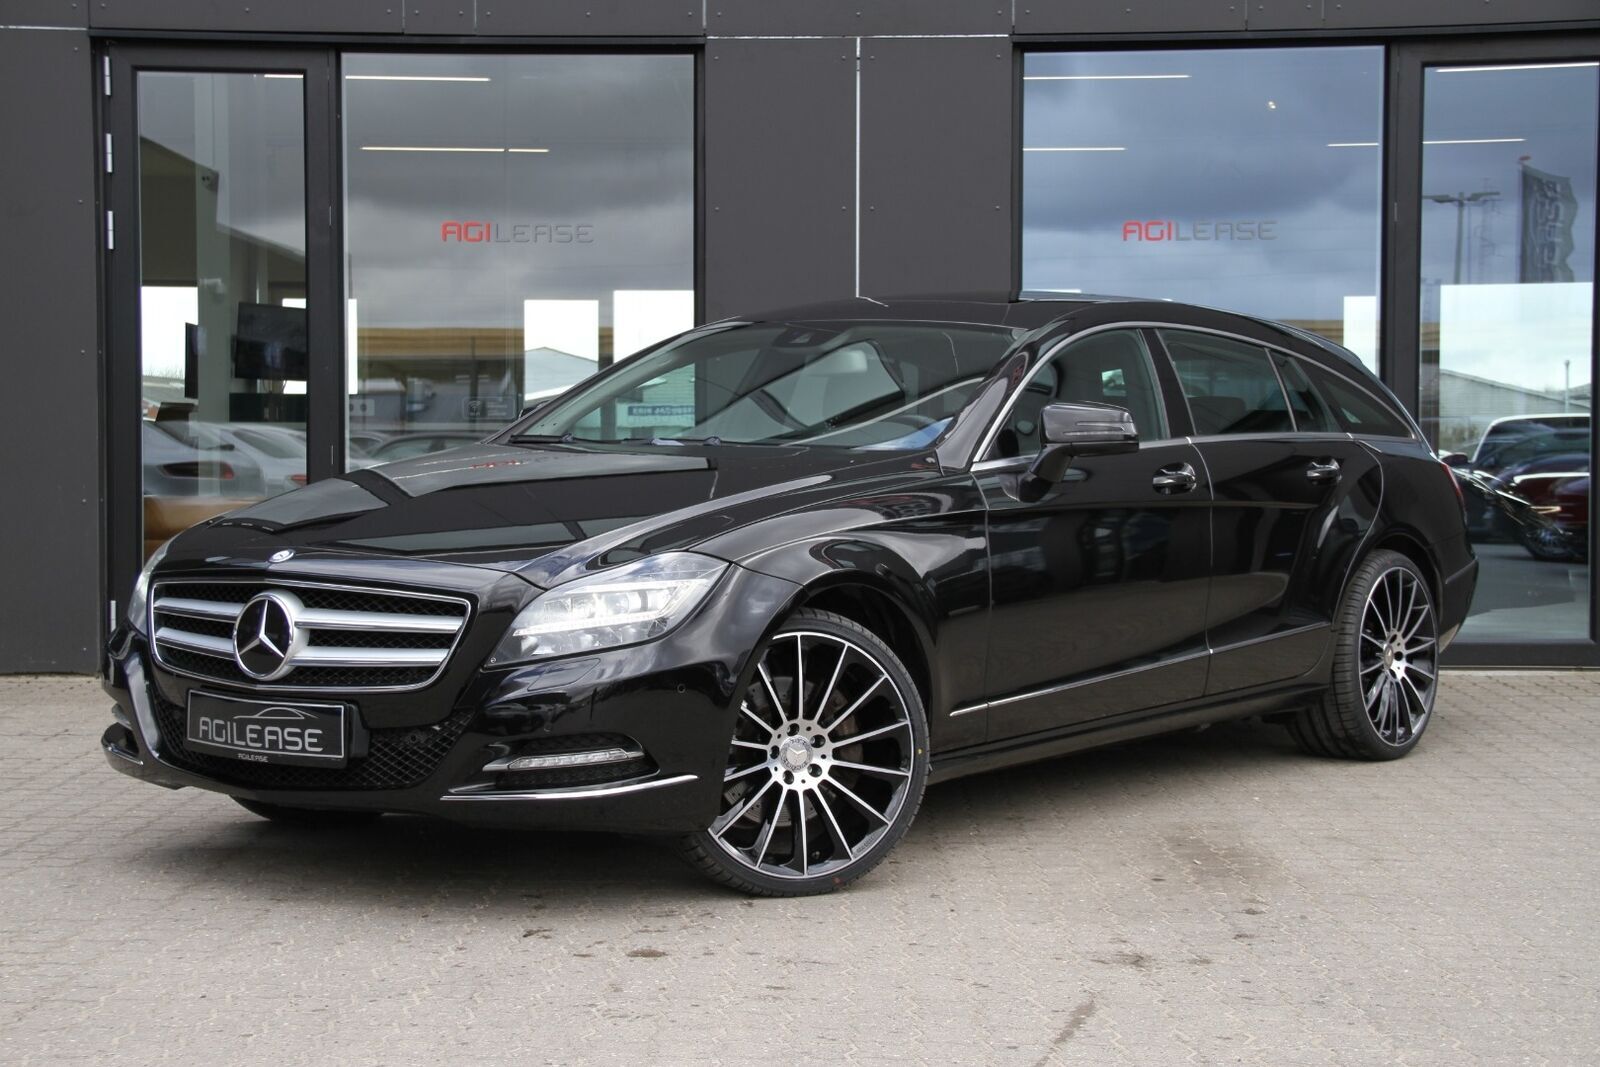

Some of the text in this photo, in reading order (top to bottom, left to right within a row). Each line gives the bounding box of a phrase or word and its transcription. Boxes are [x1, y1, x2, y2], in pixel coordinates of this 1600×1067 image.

[441, 221, 594, 244] AGILEASE
[1122, 220, 1279, 242] AGILEASE
[199, 716, 323, 752] AGILEASE
